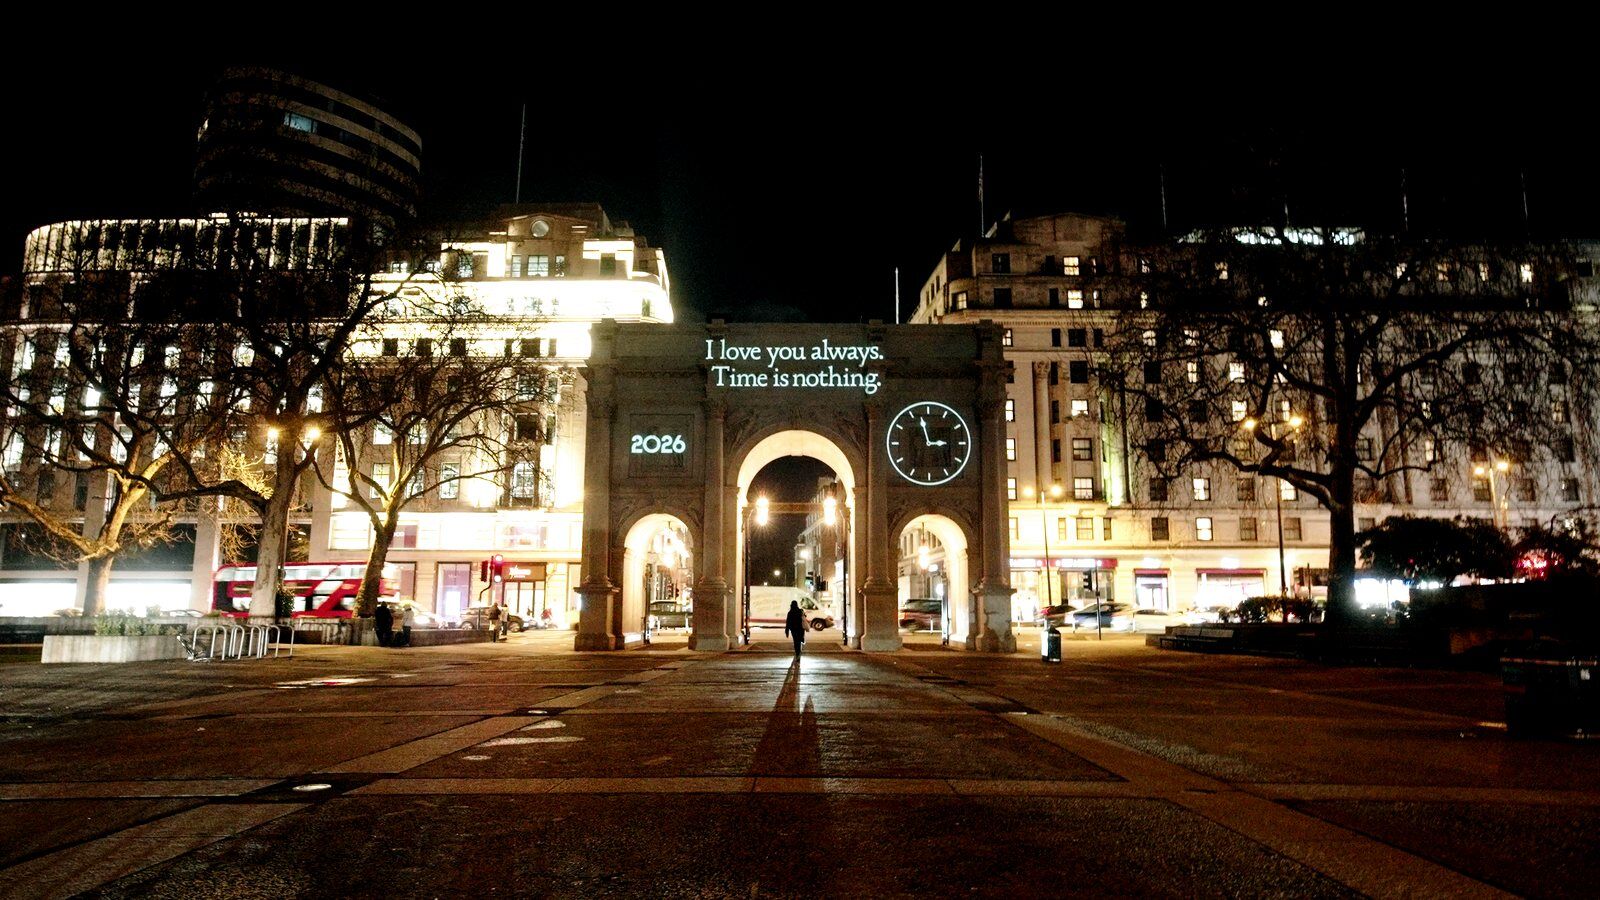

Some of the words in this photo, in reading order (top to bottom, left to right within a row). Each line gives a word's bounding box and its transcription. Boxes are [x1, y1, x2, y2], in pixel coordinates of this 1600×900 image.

[705, 339, 713, 360] I
[720, 338, 762, 361] love
[766, 345, 806, 368] you
[811, 338, 884, 368] always.
[711, 366, 768, 387] Time
[773, 368, 790, 387] is
[792, 365, 882, 395] nothing.
[630, 434, 687, 454] 2026
